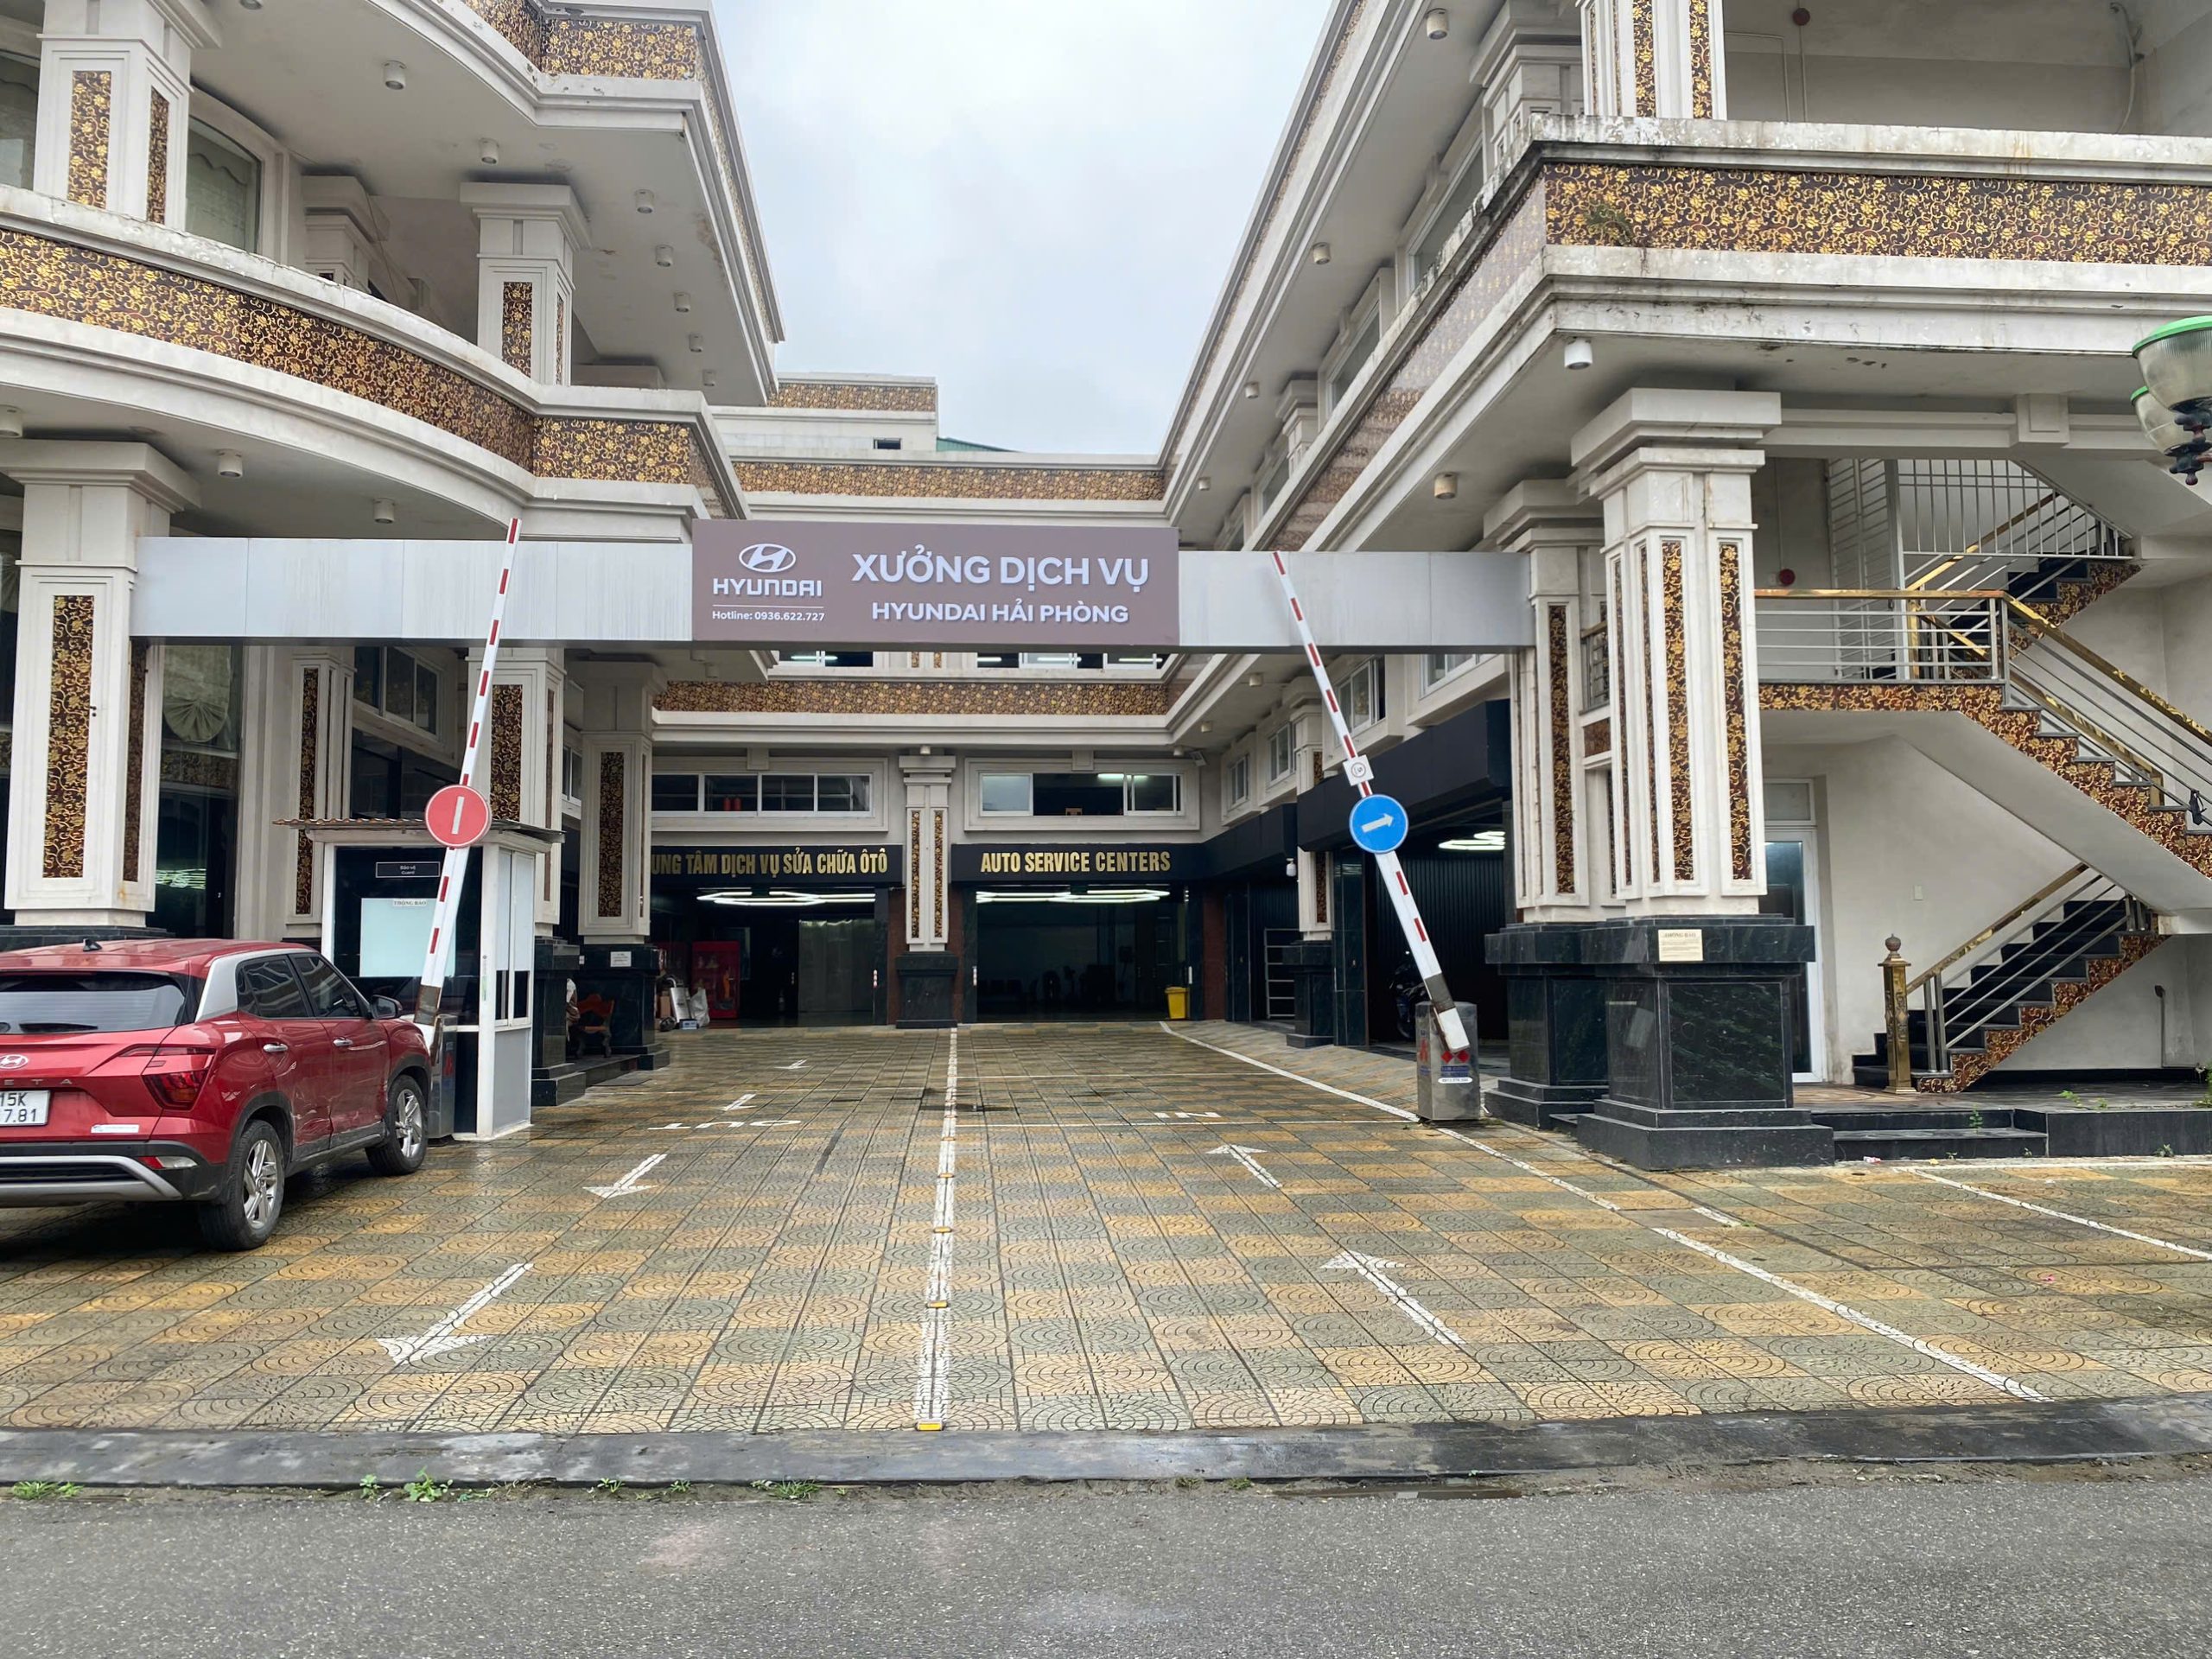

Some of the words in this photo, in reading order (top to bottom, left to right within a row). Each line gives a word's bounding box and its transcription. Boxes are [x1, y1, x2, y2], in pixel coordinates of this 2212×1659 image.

[851, 543, 991, 585] XƯỞNG
[1000, 555, 1090, 592] DỊCH
[1097, 556, 1149, 593] VỤ
[712, 578, 823, 597] HYUNDAI
[712, 610, 753, 620] Hotline:
[754, 612, 825, 622] 0936.622.727
[872, 601, 986, 621] HYUNDAI
[992, 598, 1033, 623] HẢI
[1039, 600, 1128, 624] PHÒNG
[685, 850, 718, 874] TÂM
[721, 854, 755, 878] DỊCH
[760, 854, 779, 879] VỤ
[783, 847, 813, 874] SỬA
[817, 849, 856, 874] CHỮA
[860, 848, 887, 874] ÔTÔ
[981, 851, 1020, 873] AUTO
[1024, 851, 1090, 873] SERVICE
[1095, 851, 1171, 872] CENTERS
[0, 1091, 29, 1107] 15K
[3, 1109, 37, 1122] 7.81
